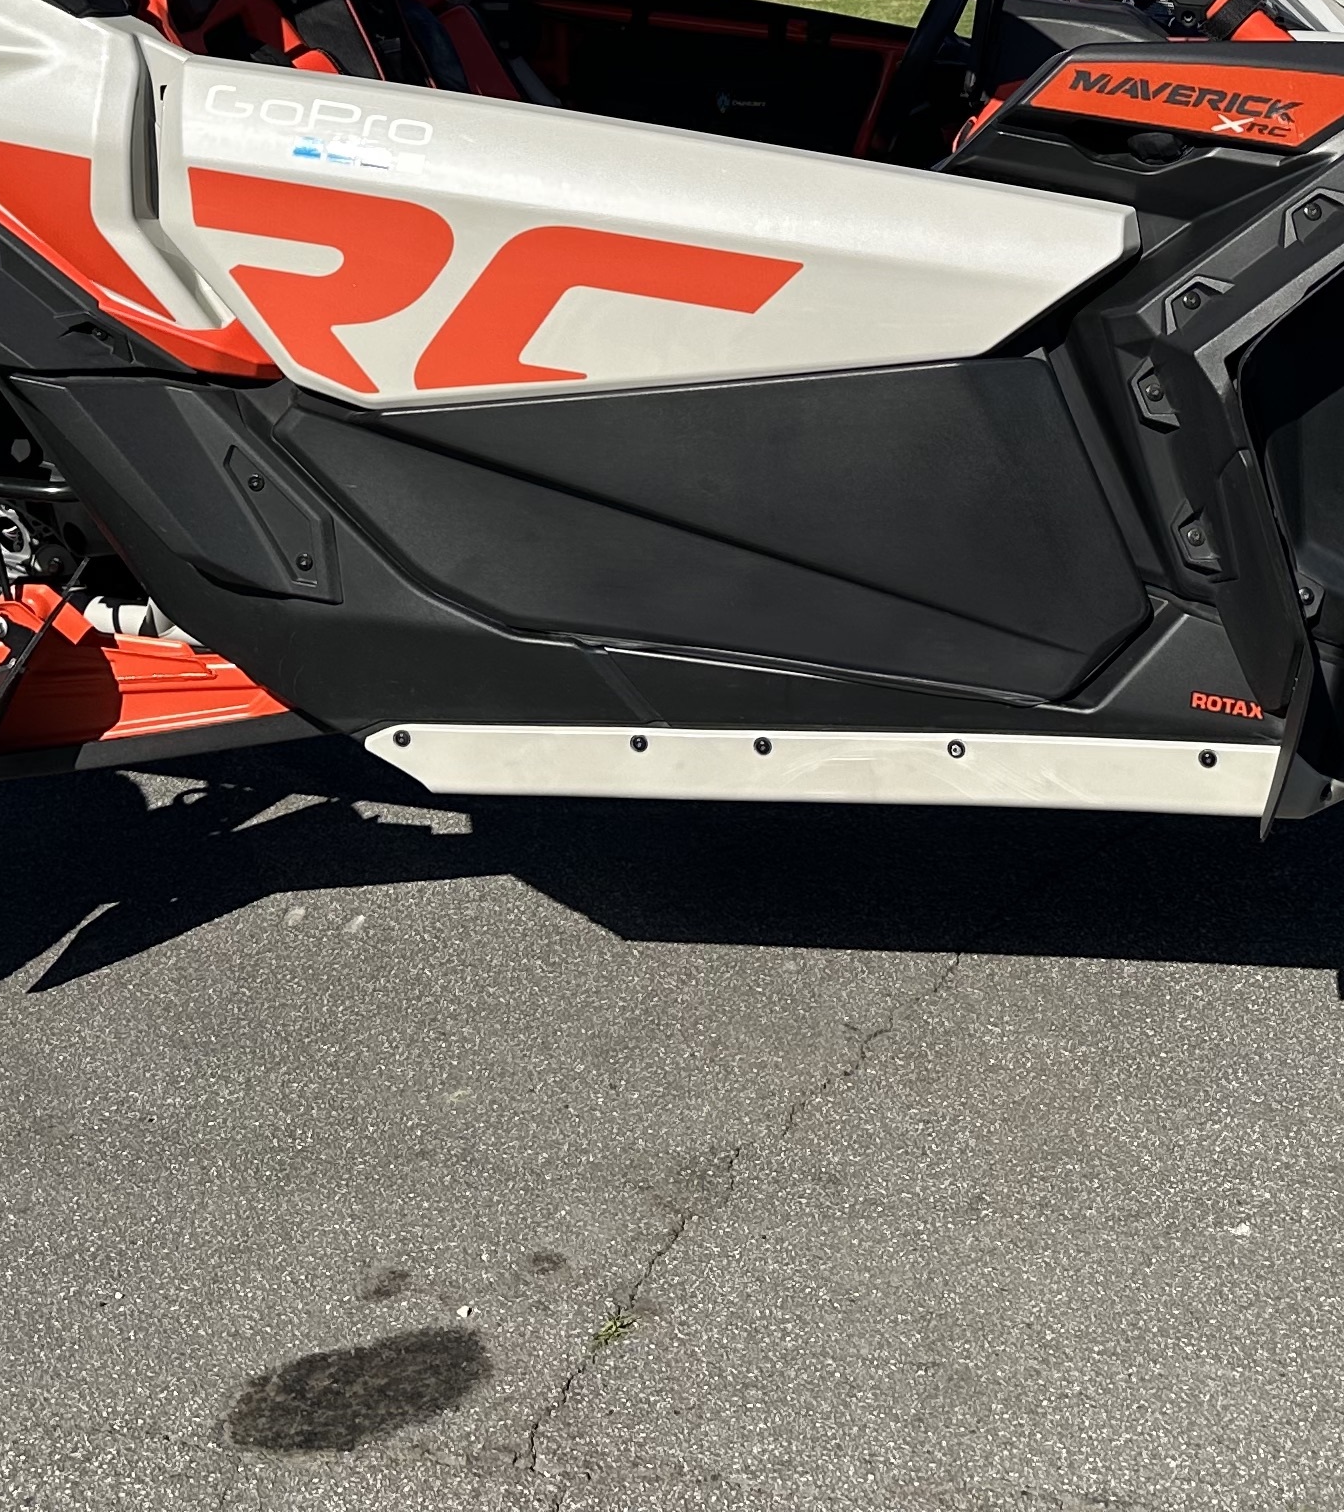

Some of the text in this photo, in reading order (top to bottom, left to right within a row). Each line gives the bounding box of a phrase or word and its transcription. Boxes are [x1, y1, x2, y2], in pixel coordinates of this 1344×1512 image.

[204, 84, 434, 146] GoPro
[1068, 68, 1304, 124] MAVERICK
[187, 166, 804, 394] RC
[1190, 690, 1264, 721] ROTAX
